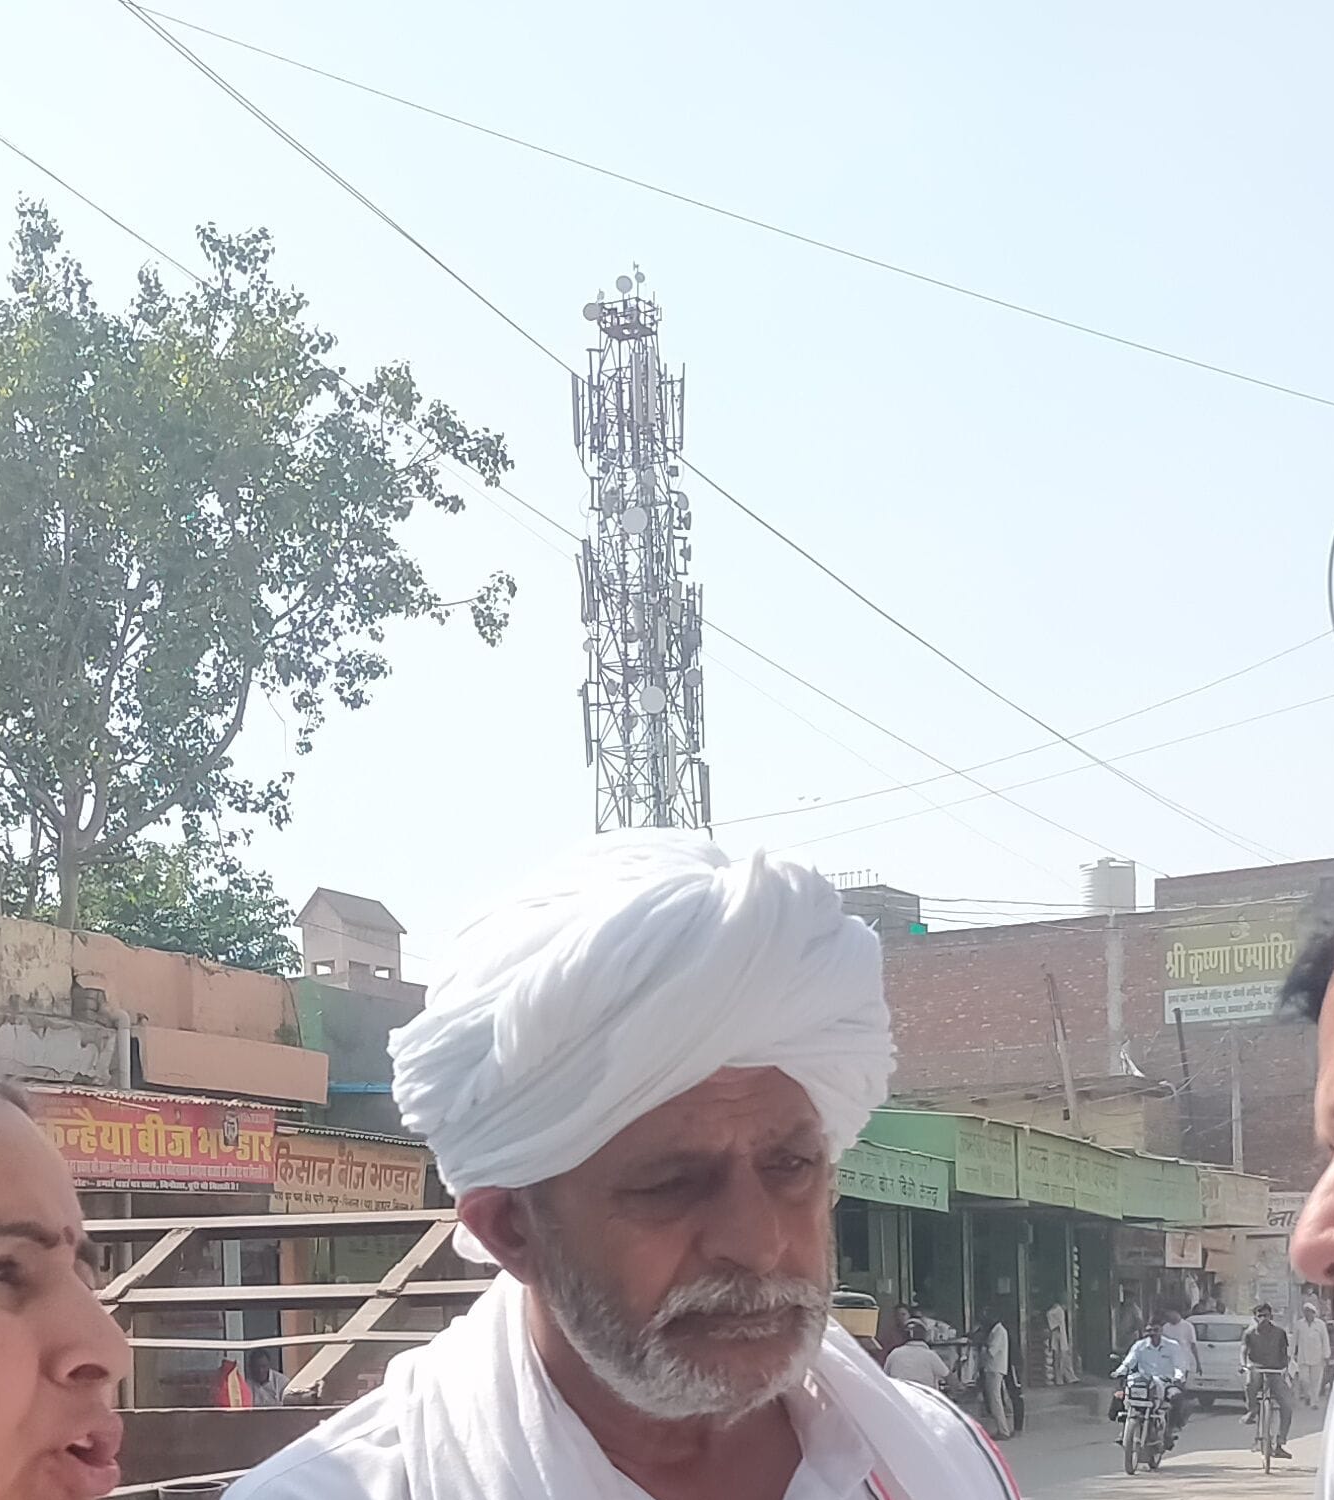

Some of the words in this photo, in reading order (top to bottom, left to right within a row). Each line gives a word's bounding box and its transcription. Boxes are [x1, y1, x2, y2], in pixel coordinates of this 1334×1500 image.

[1166, 943, 1185, 979] श्री
[1186, 946, 1231, 984] कृष्णा
[136, 1114, 193, 1158] बीज
[276, 1141, 334, 1187] किसान
[338, 1150, 367, 1190] बीज
[370, 1162, 421, 1196] भण्डार
